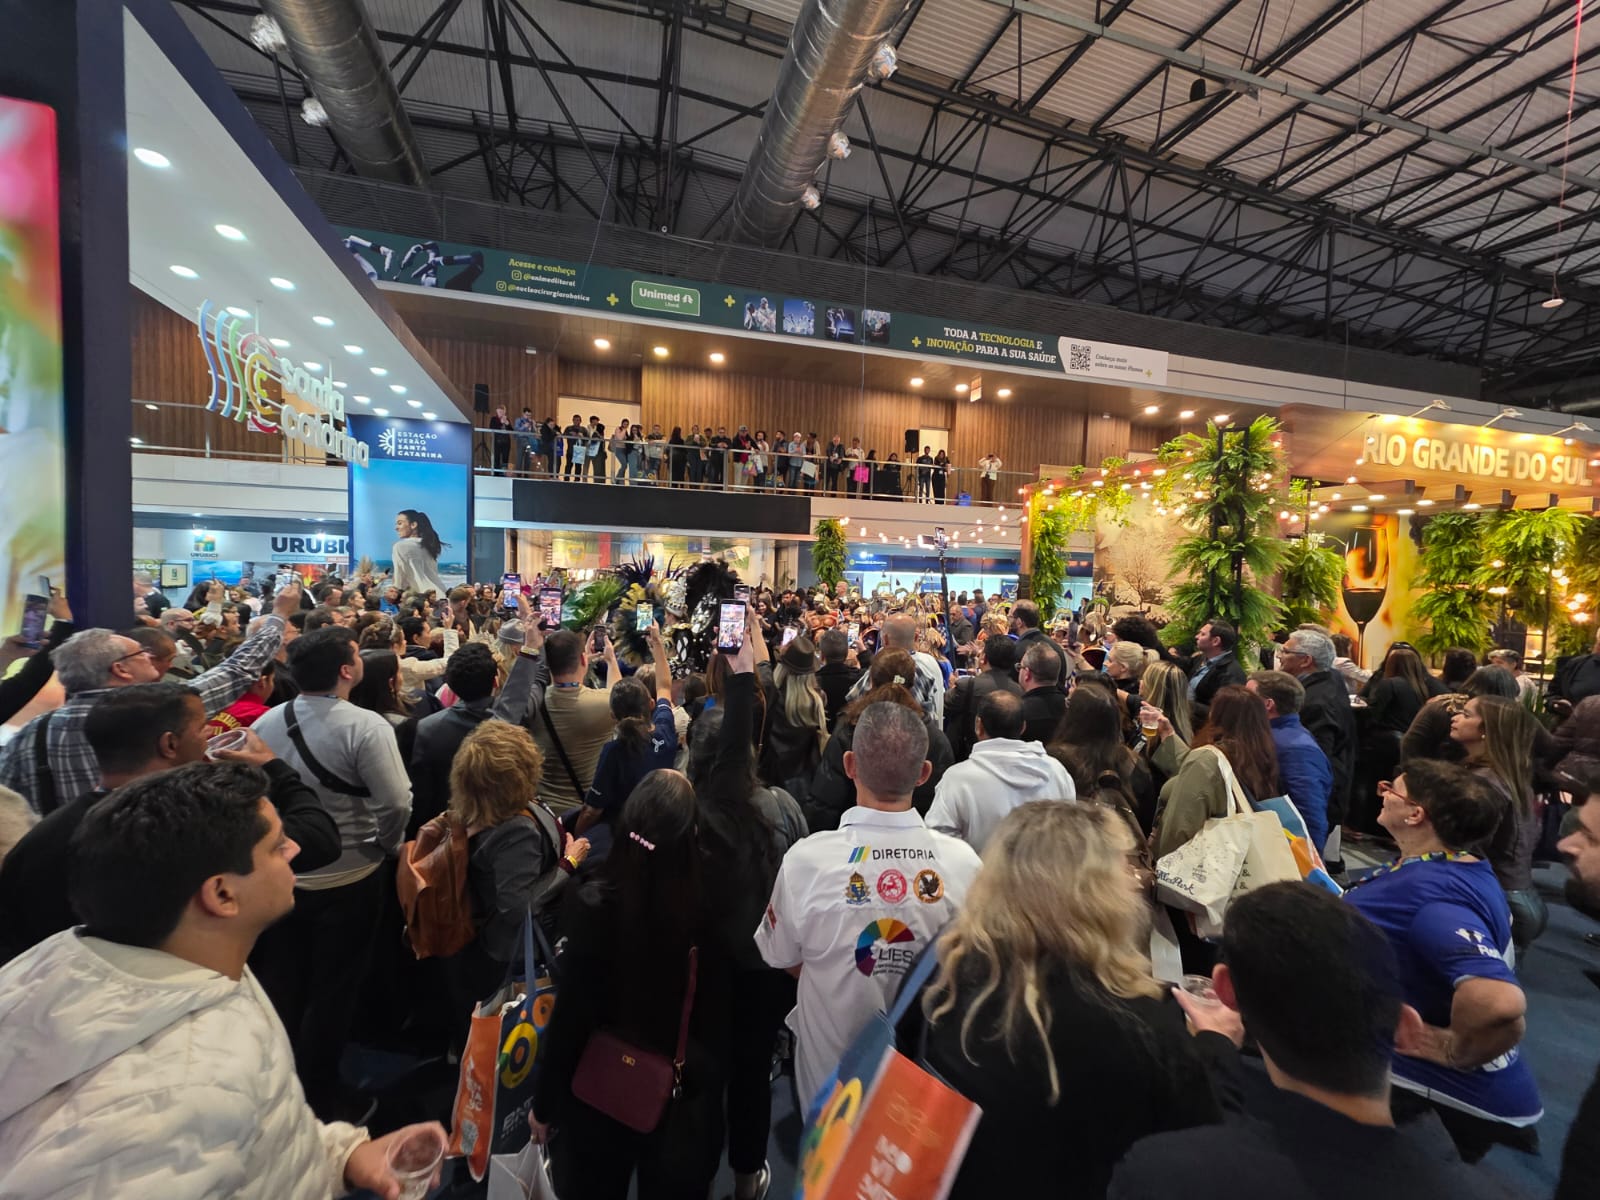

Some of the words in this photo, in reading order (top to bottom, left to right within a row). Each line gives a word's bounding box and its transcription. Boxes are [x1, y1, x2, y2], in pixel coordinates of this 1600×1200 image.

[508, 258, 536, 269] Acesse
[543, 264, 576, 276] conheça
[639, 287, 680, 302] Unimed
[943, 327, 969, 339] TODA
[970, 331, 978, 341] A
[979, 332, 1035, 349] TECNOLOGIA
[1036, 340, 1043, 350] E
[926, 337, 974, 353] INOVAÇÃO
[975, 344, 999, 356] PARA
[1001, 348, 1008, 357] A
[1009, 349, 1027, 360] SUA
[1028, 351, 1056, 364] SAÚDE
[280, 357, 345, 422] Santa
[281, 404, 370, 468] Catarina
[397, 431, 438, 440] ESTAÇÃO
[397, 450, 443, 459] CATARINA
[1362, 431, 1407, 467] RIO
[1412, 437, 1509, 478] GRANDE
[1515, 450, 1547, 482] DO
[1550, 455, 1593, 487] SUL
[872, 848, 936, 861] DIRETORIA
[879, 948, 914, 965] LIES
